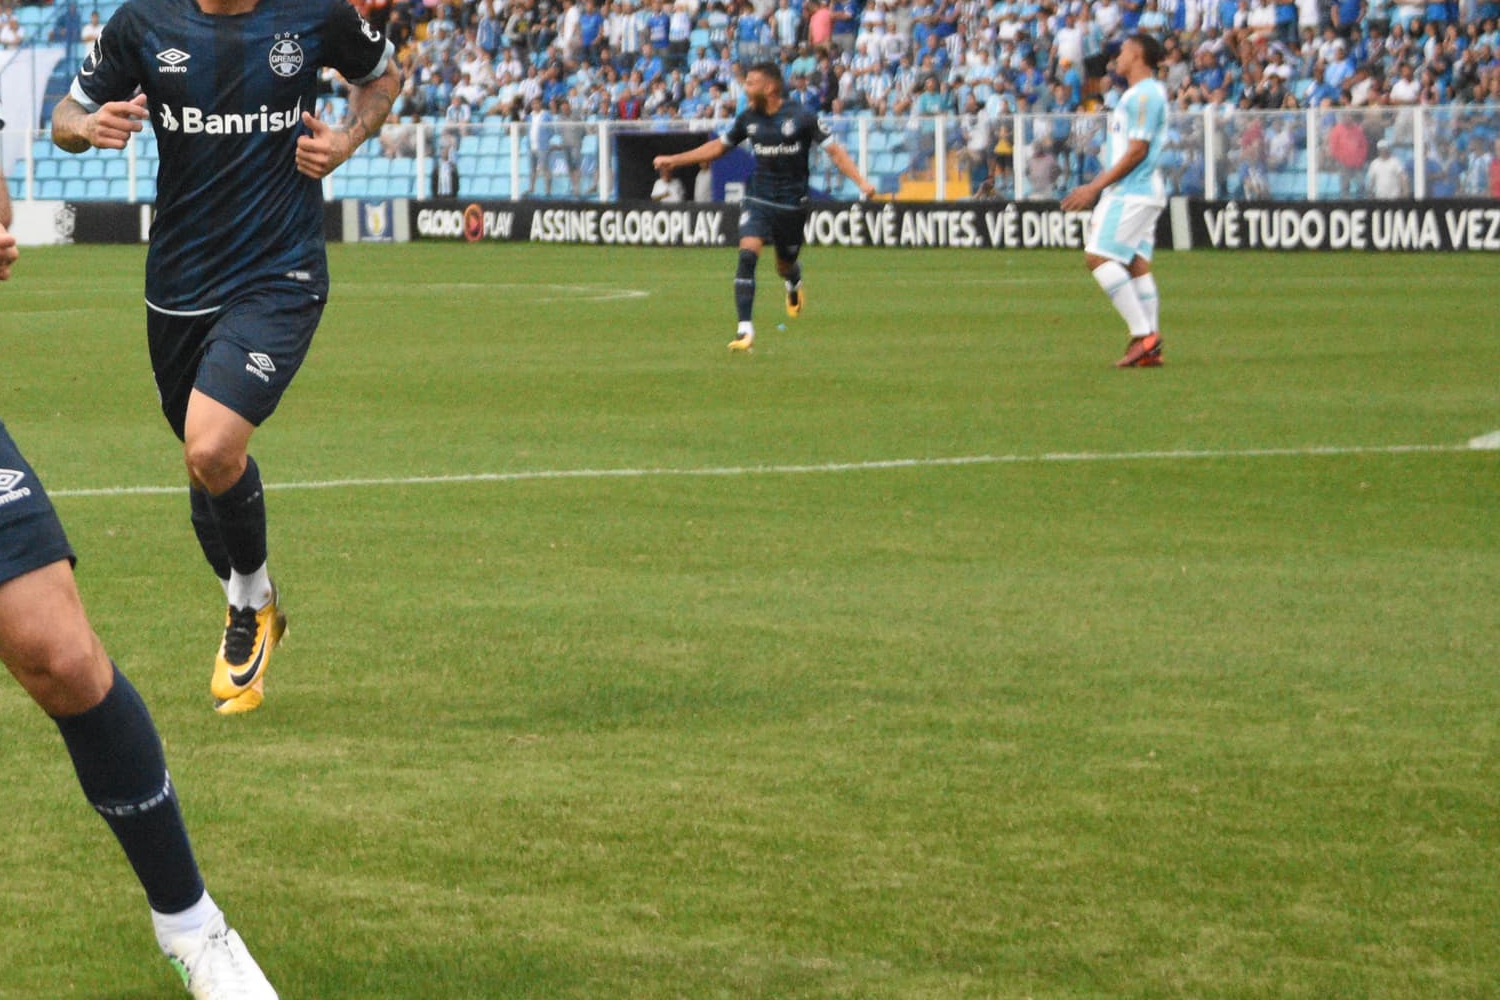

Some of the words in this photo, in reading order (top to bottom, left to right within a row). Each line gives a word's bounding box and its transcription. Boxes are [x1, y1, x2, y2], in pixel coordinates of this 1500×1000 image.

[158, 64, 188, 73] umbro
[181, 95, 301, 134] Banrisul
[530, 208, 599, 242] ASSINE
[600, 208, 725, 246] GLOBOPLAY.
[803, 203, 864, 246] VOCÊ
[865, 203, 899, 246] VÊ
[900, 209, 982, 247] ANTES.
[985, 203, 1019, 247] VÊ
[1203, 201, 1241, 247] VÊ
[1243, 209, 1326, 248] TUDO
[1329, 208, 1368, 248] DE
[1371, 208, 1441, 249] UMA
[1445, 208, 1500, 249] VEZ
[245, 362, 270, 383] umbro
